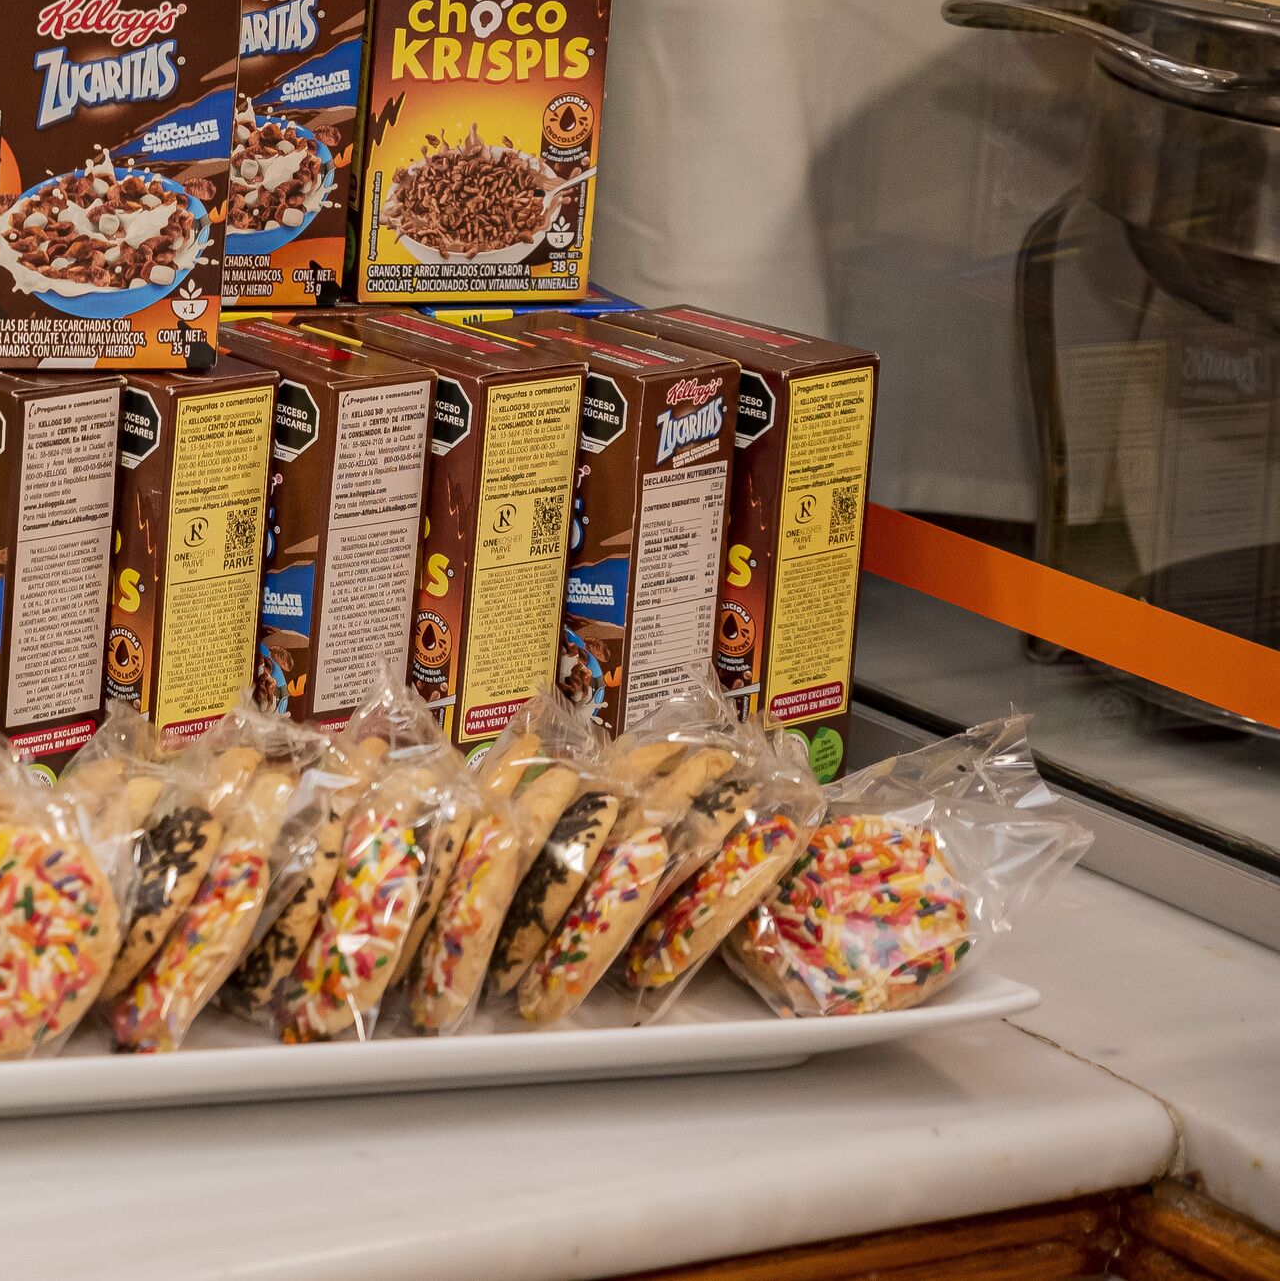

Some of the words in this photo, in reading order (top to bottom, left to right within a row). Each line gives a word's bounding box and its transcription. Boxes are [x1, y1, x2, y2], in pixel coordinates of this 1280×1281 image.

[391, 29, 591, 83] KRISPIS
[35, 41, 178, 130] ZUCARITAS
[143, 118, 219, 148] CHOCOLATE
[368, 265, 401, 277] GRANOS
[402, 265, 413, 277] DE
[414, 265, 440, 277] ARROZ
[441, 265, 479, 277] INFLADOS
[480, 265, 497, 277] CON
[498, 264, 523, 276] SABOR
[524, 265, 530, 276] A
[367, 277, 415, 294] CHOCOLATE,
[416, 278, 469, 291] ADICIONADOS
[471, 278, 487, 291] CON
[488, 277, 529, 291] VITAMINAS
[531, 279, 537, 290] Y
[538, 277, 579, 290] MINERALES
[492, 391, 528, 403] ¿Preguntas
[534, 383, 576, 396] comentarios?
[656, 397, 723, 466] ZUCARITAS
[644, 472, 685, 487] DECLARACIÓN
[686, 465, 726, 479] NUTRIMENTAL
[530, 542, 560, 556] PARVE
